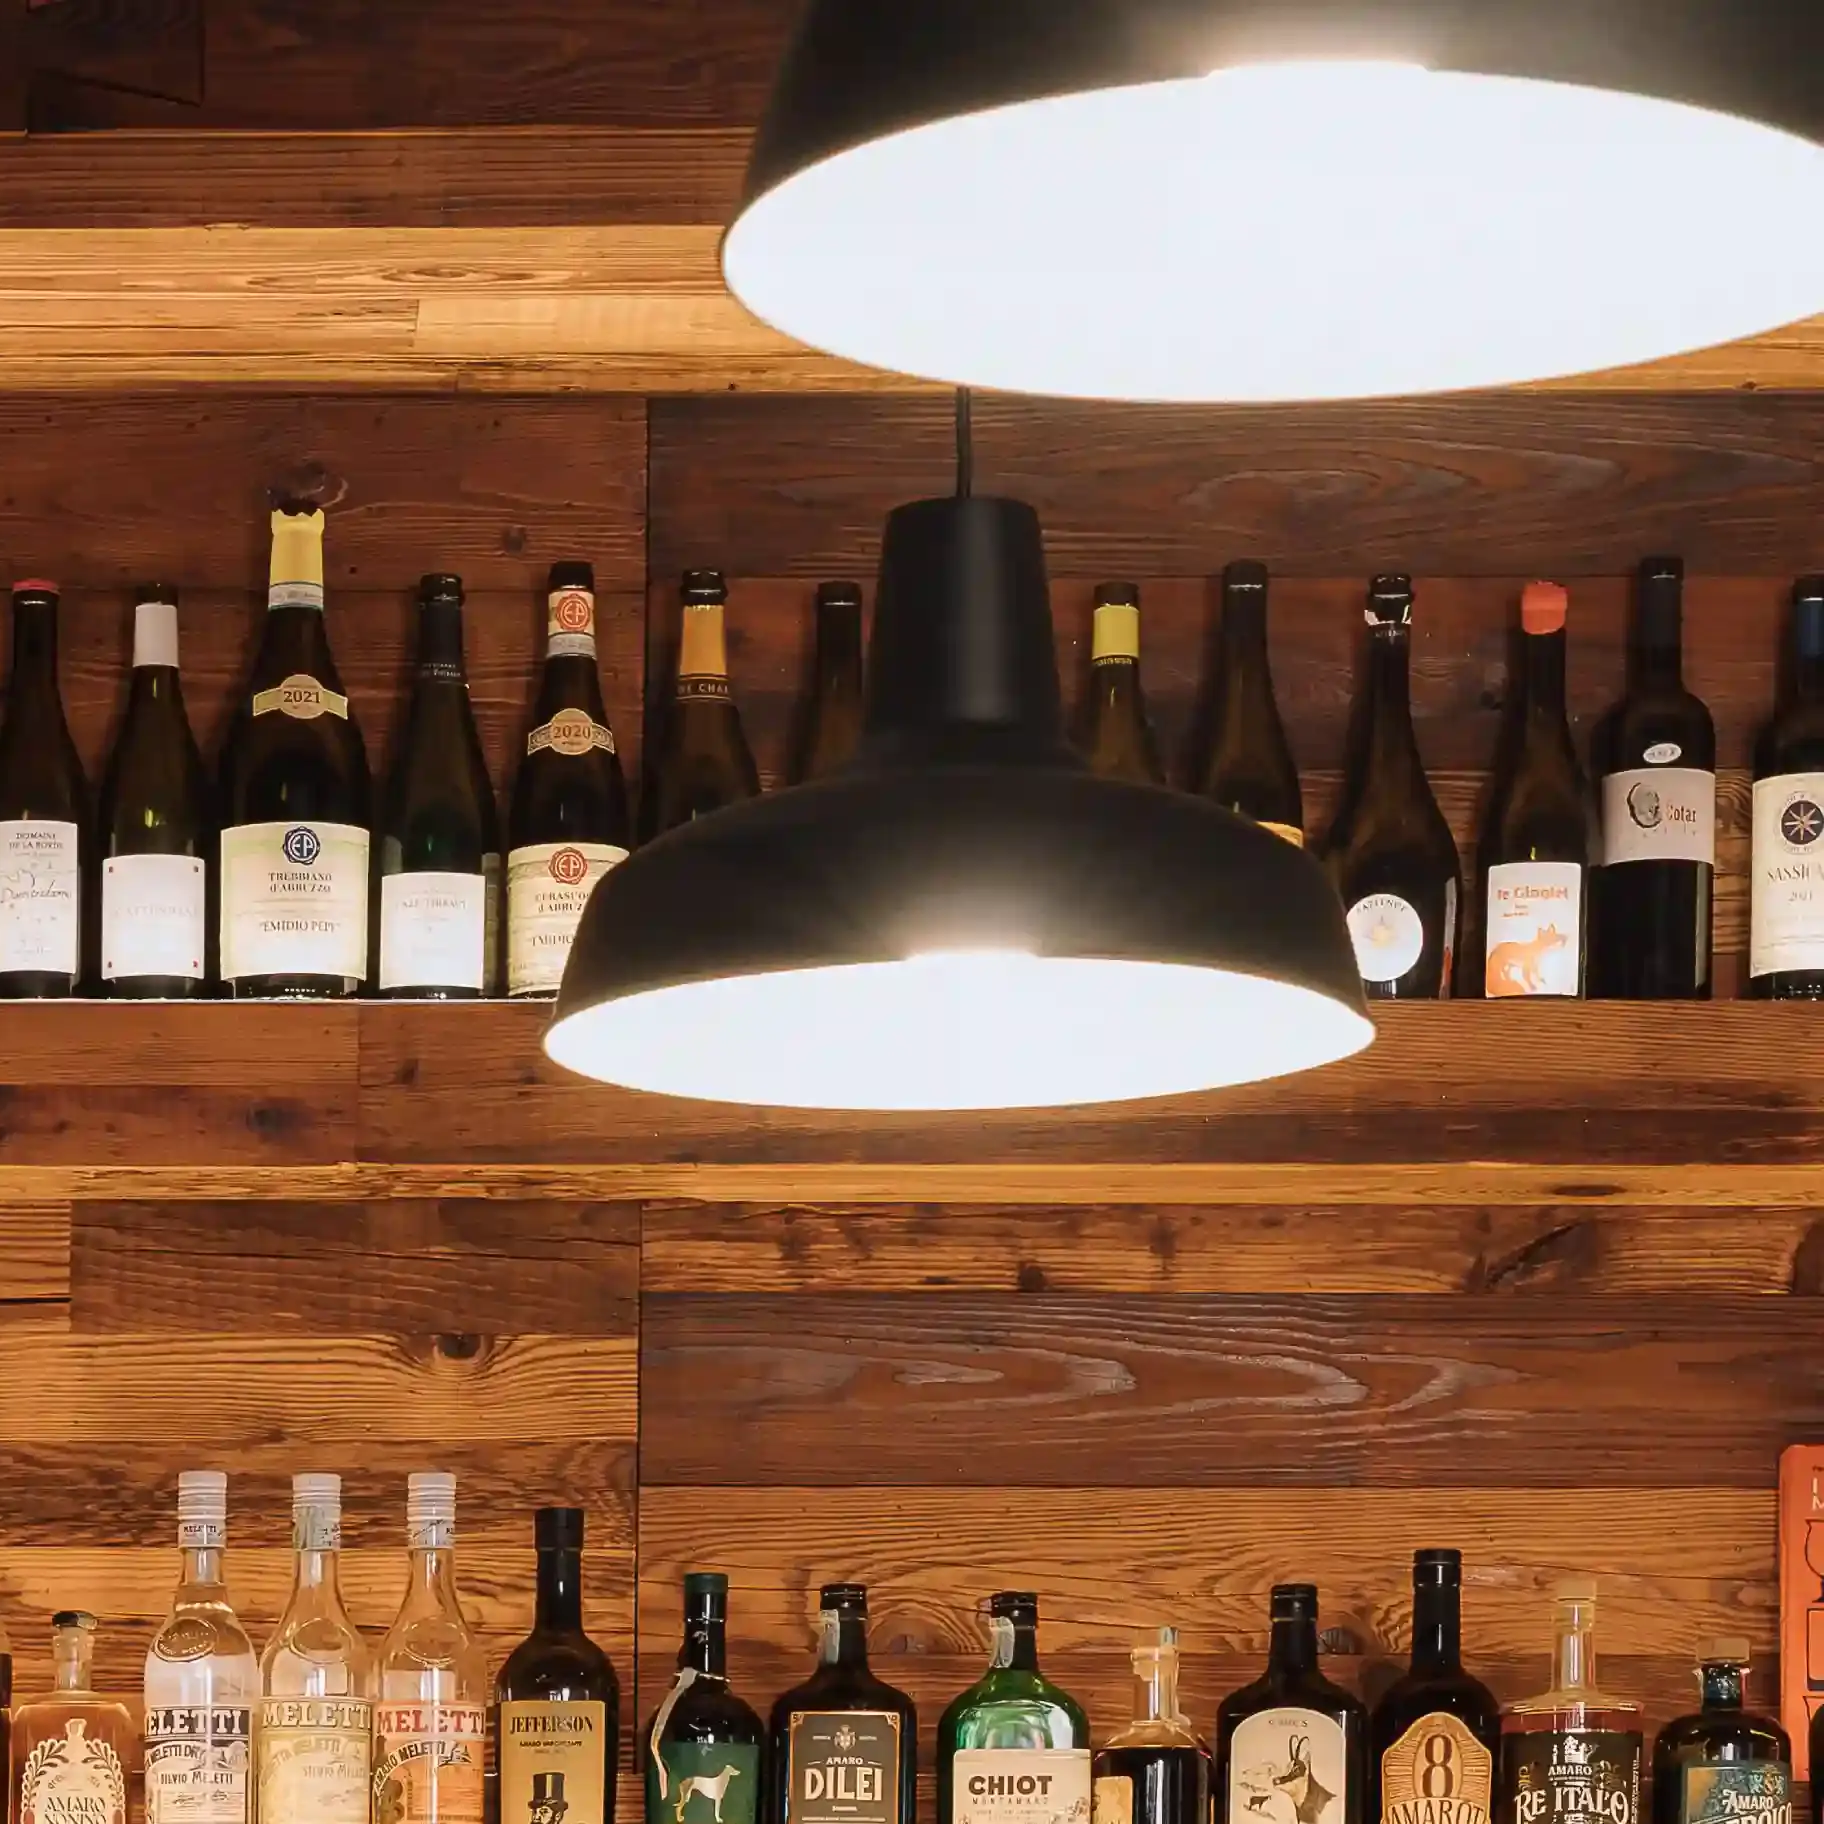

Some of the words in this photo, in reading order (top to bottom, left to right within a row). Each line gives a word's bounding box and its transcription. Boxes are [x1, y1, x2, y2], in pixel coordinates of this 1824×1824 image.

[283, 690, 321, 704] 2021
[553, 724, 591, 740] 2020
[268, 871, 332, 882] TREBBIANO
[376, 1709, 486, 1734] MELETTI
[508, 1715, 594, 1735] JEFFERSON
[826, 1756, 864, 1766] AMARO
[1421, 1734, 1453, 1798] 8
[1547, 1764, 1593, 1777] AMARO
[803, 1767, 884, 1802] DILEI
[968, 1775, 1053, 1796] CHIOT
[43, 1796, 106, 1813] AMARO
[1721, 1788, 1774, 1815] AMARO
